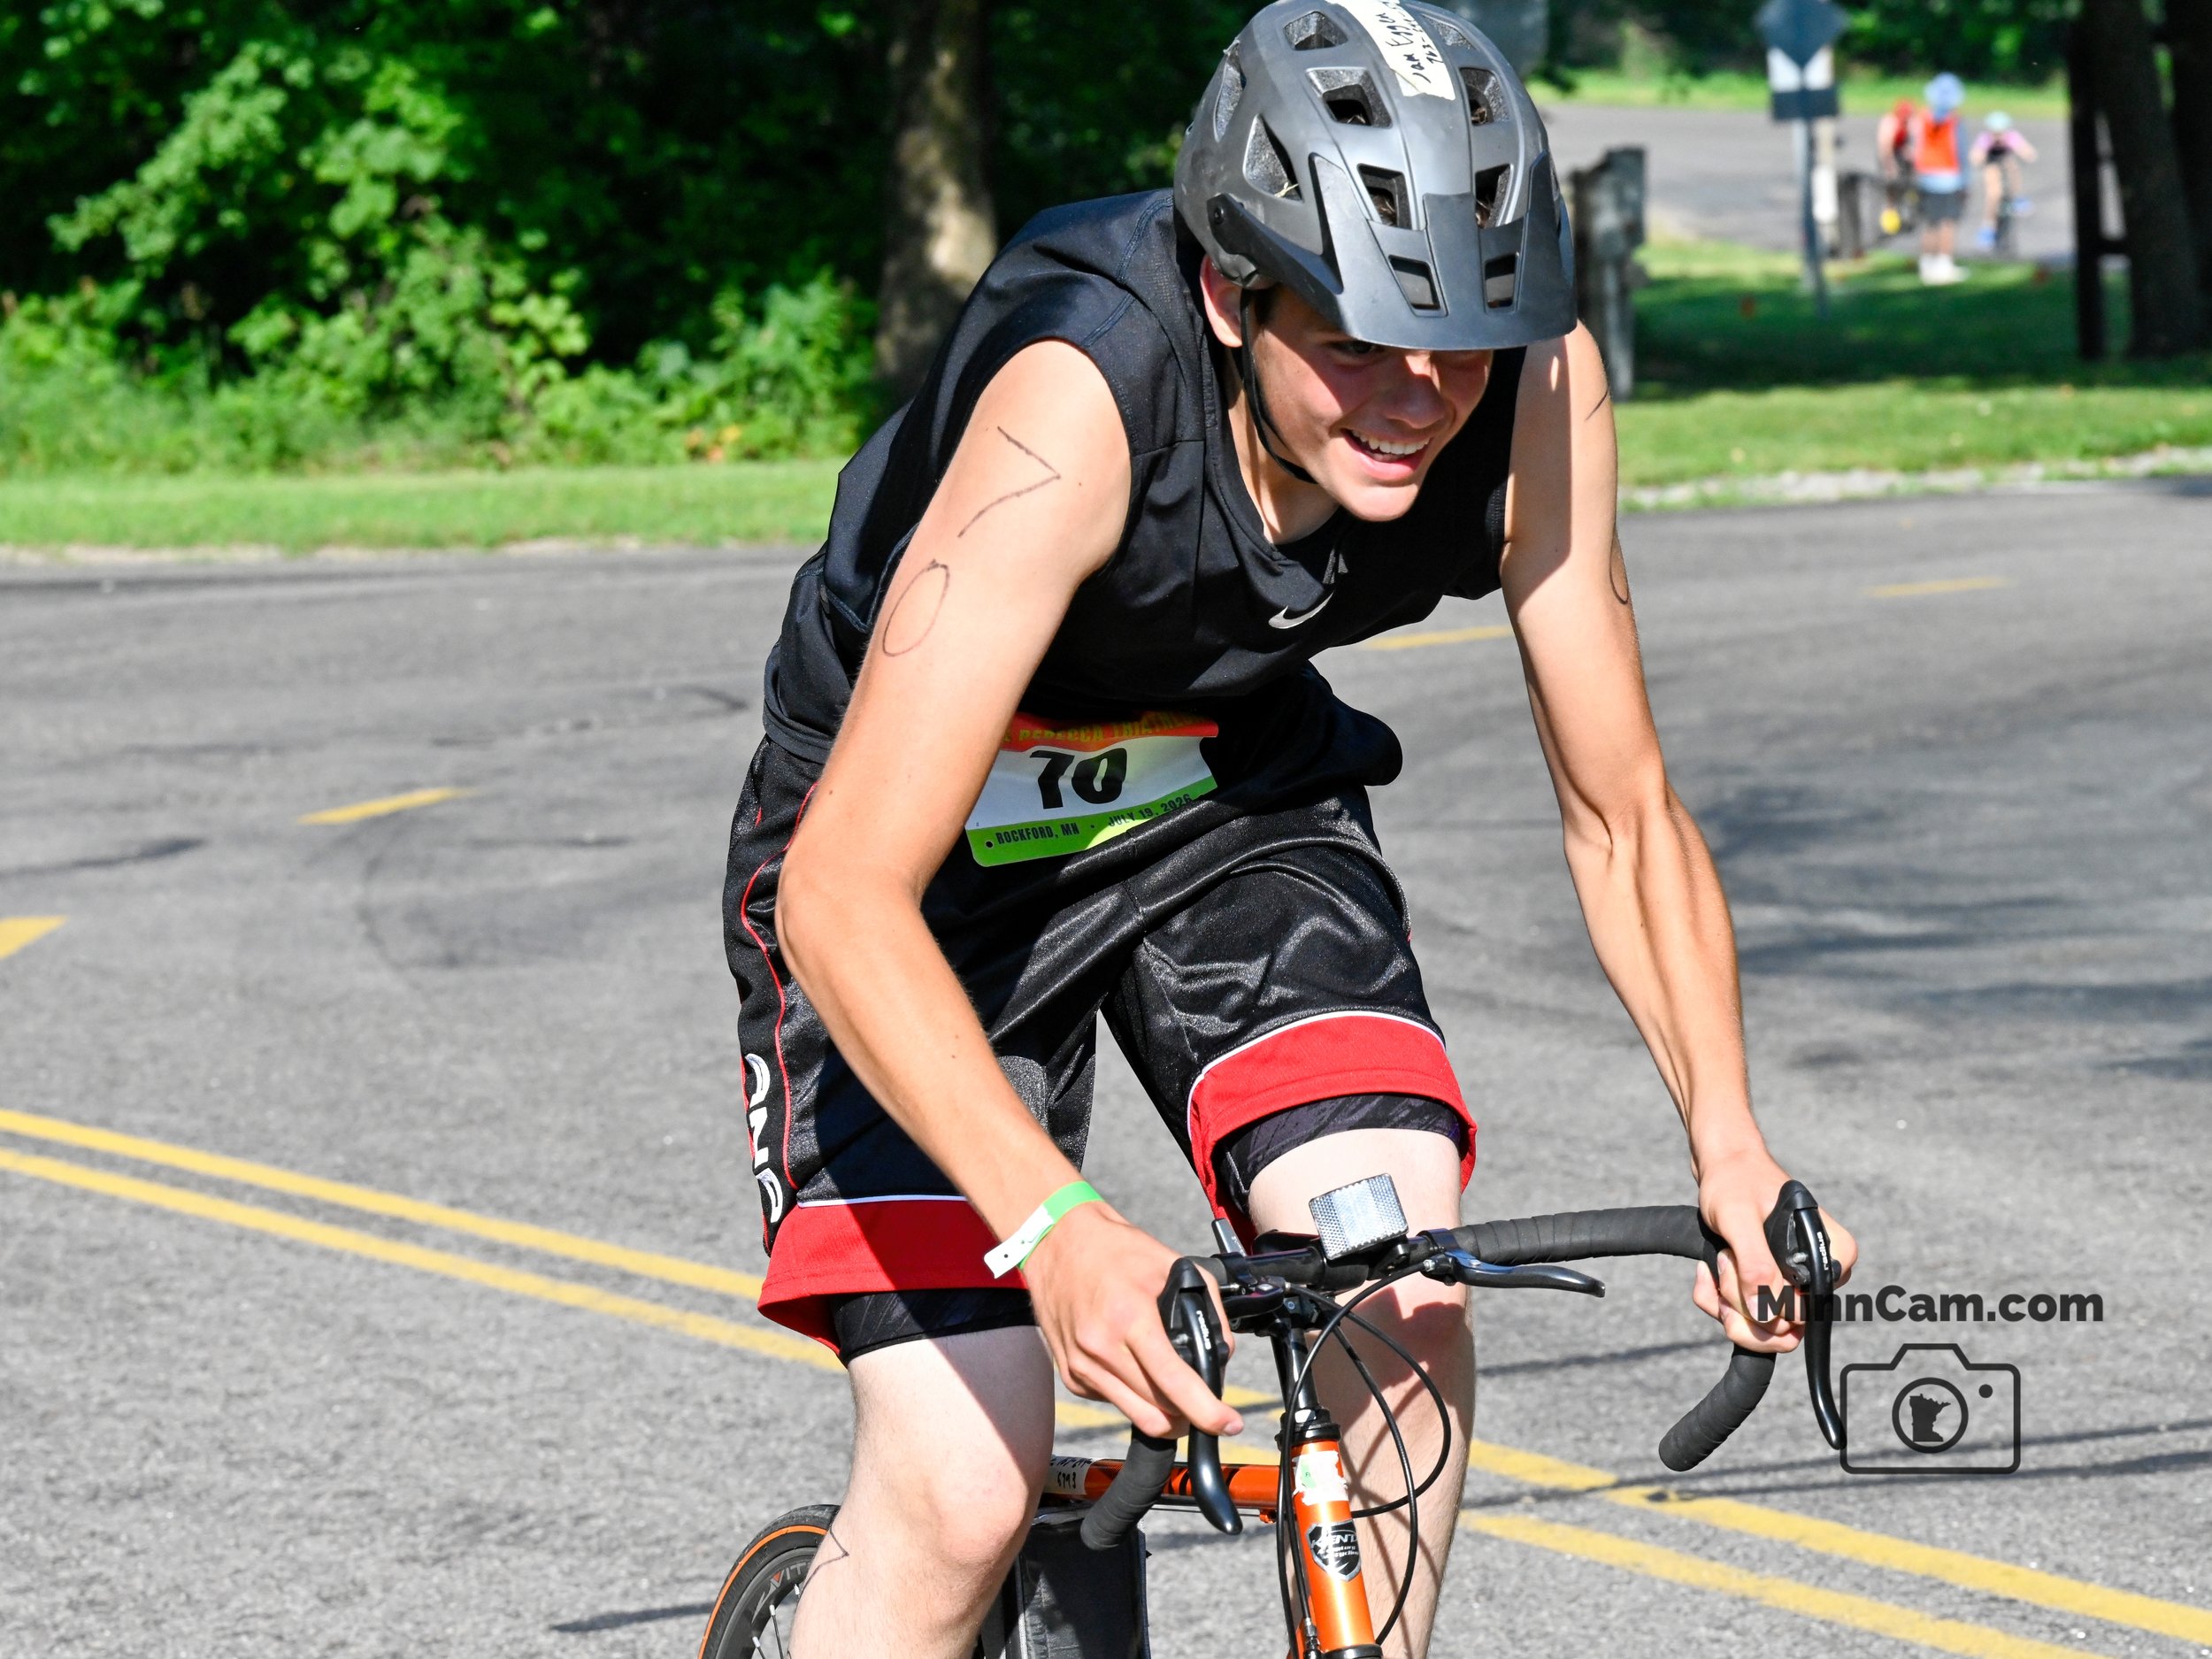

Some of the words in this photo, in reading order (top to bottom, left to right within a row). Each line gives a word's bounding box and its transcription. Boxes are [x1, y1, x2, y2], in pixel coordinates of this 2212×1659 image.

[1029, 747, 1128, 810] 70
[995, 826, 1059, 845] ROCKFORD,
[1062, 822, 1080, 837] MN
[1108, 811, 1136, 827] JULY
[1160, 794, 1193, 816] 2026
